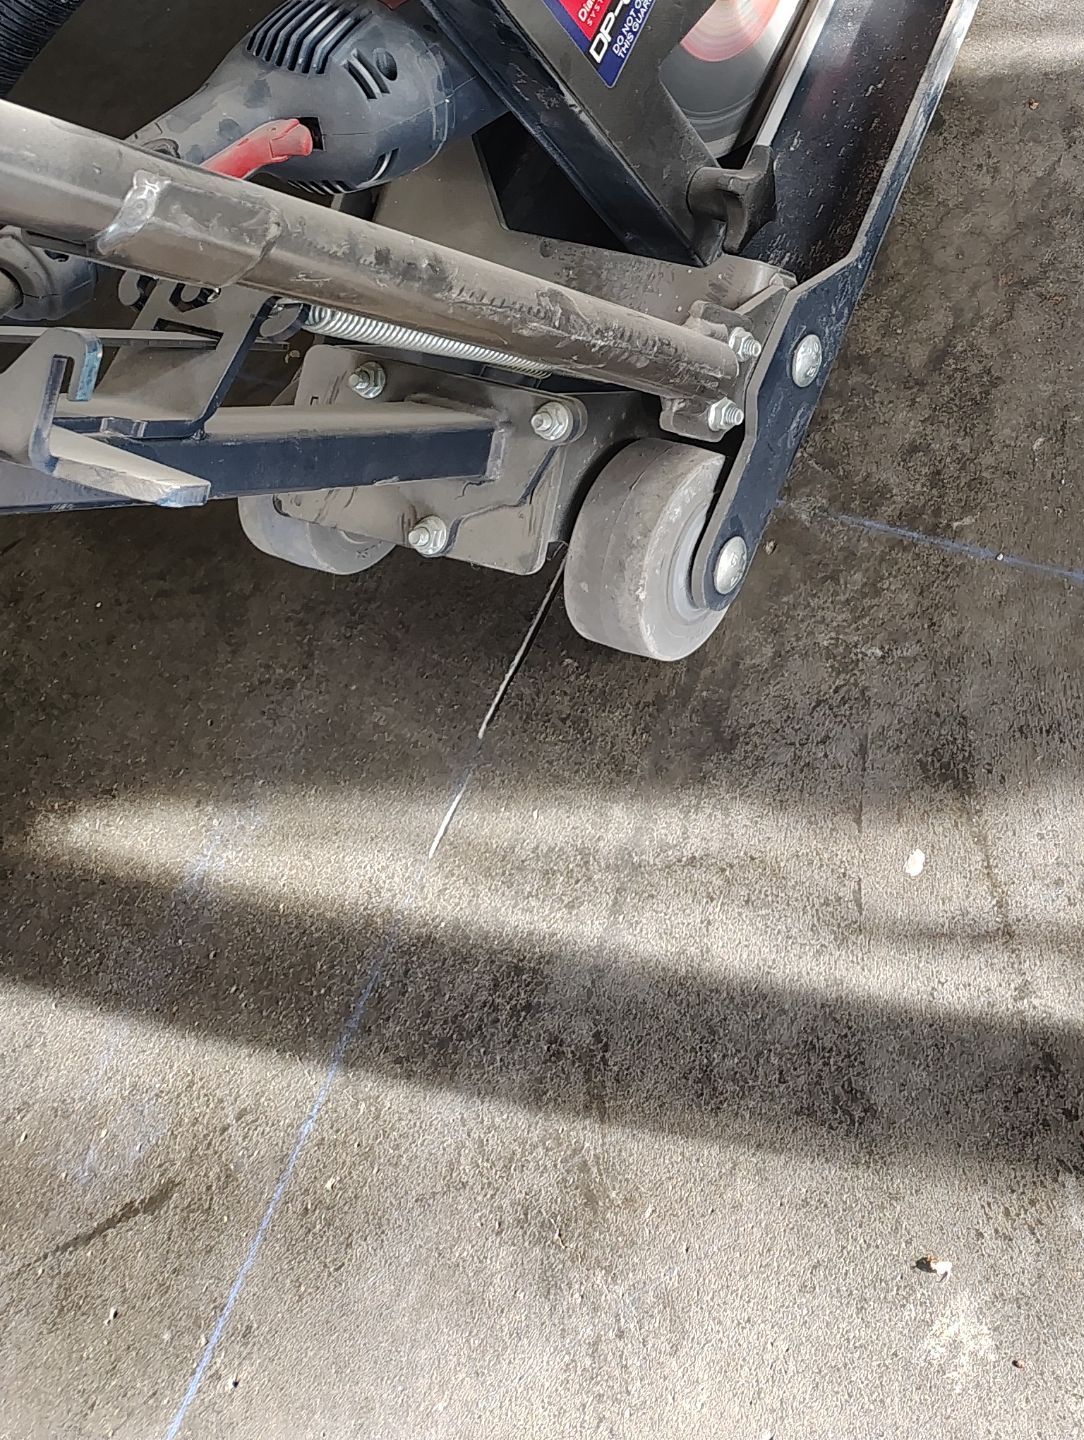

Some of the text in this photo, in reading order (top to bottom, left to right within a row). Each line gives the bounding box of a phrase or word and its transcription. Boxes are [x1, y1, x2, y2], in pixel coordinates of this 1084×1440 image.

[612, 35, 625, 54] DO
[621, 8, 637, 36] NOT
[617, 32, 634, 58] THIS
